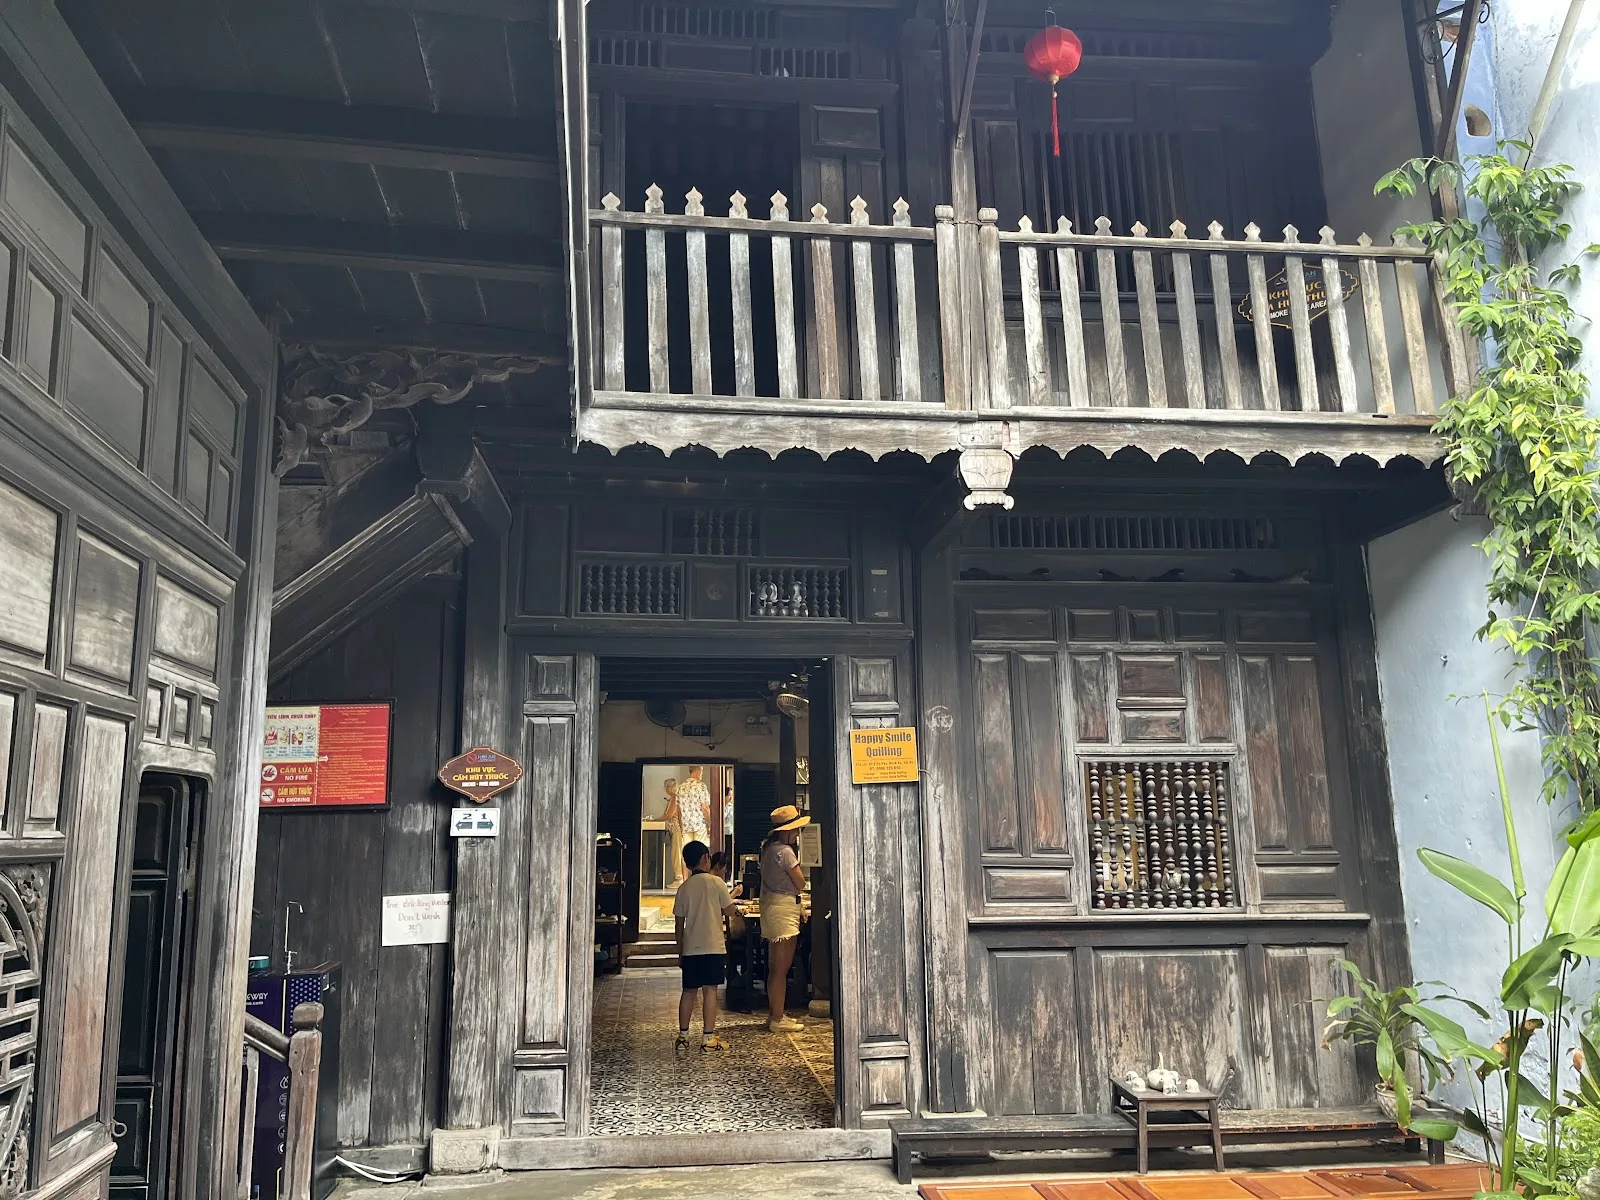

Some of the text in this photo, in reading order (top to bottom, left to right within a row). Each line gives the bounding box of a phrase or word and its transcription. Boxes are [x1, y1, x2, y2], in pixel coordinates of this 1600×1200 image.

[1270, 309, 1289, 319] MOKE
[855, 732, 912, 744] Happy Smile
[866, 747, 902, 758] Quilling
[280, 763, 313, 774] CẤM LỬA
[246, 992, 269, 1001] EWAY
